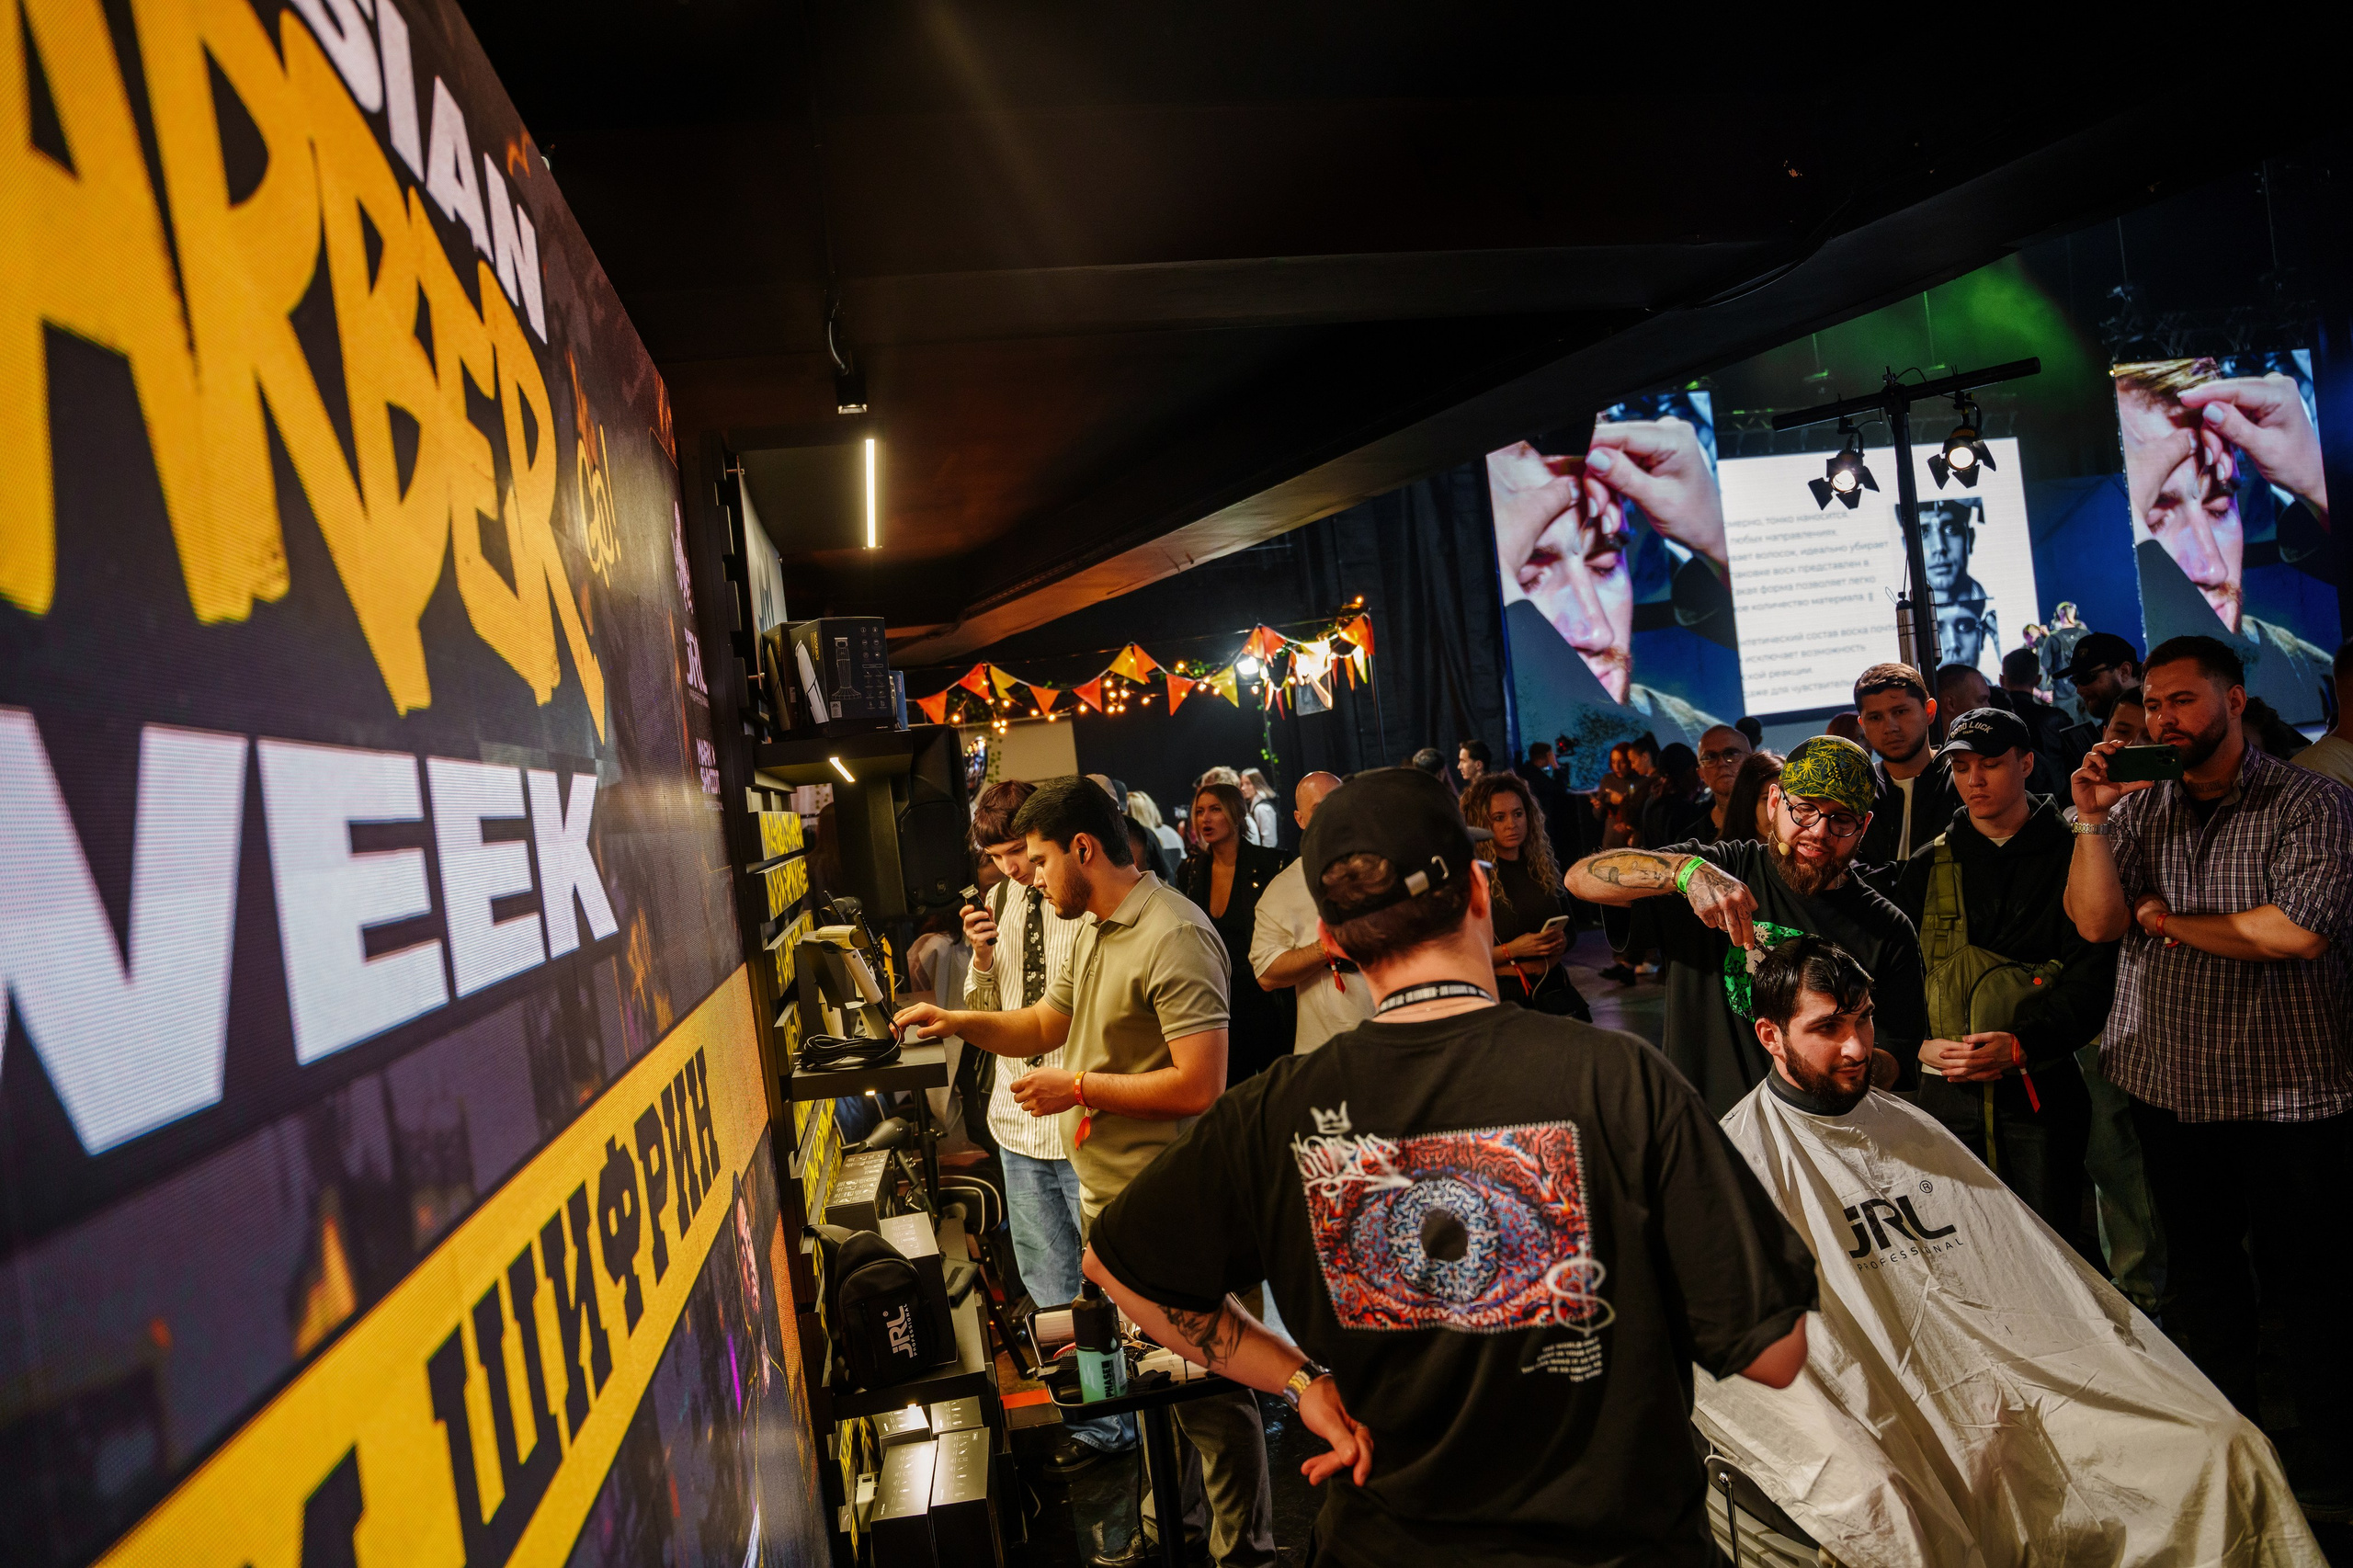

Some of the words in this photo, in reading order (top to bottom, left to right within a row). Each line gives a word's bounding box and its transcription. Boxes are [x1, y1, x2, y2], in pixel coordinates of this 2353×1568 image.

[1801, 544, 1847, 556] идеально
[1850, 540, 1889, 552] убирает
[1773, 566, 1796, 575] воск
[1798, 561, 1861, 574] представлен
[1760, 583, 1793, 595] форма
[1795, 578, 1847, 590] позволяет
[1848, 574, 1876, 585] легко
[1752, 599, 1810, 611] количество
[1806, 629, 1838, 641] состав
[1801, 644, 1867, 657] возможность
[684, 628, 709, 696] JRL
[1969, 722, 1993, 733] LUCK
[1843, 1195, 1957, 1259] JRL
[1857, 1238, 1964, 1272] PROFESSIONAL
[886, 1305, 914, 1358] JRL
[904, 1303, 917, 1357] PROFESSIONAL
[1102, 1369, 1114, 1398] PHASE
